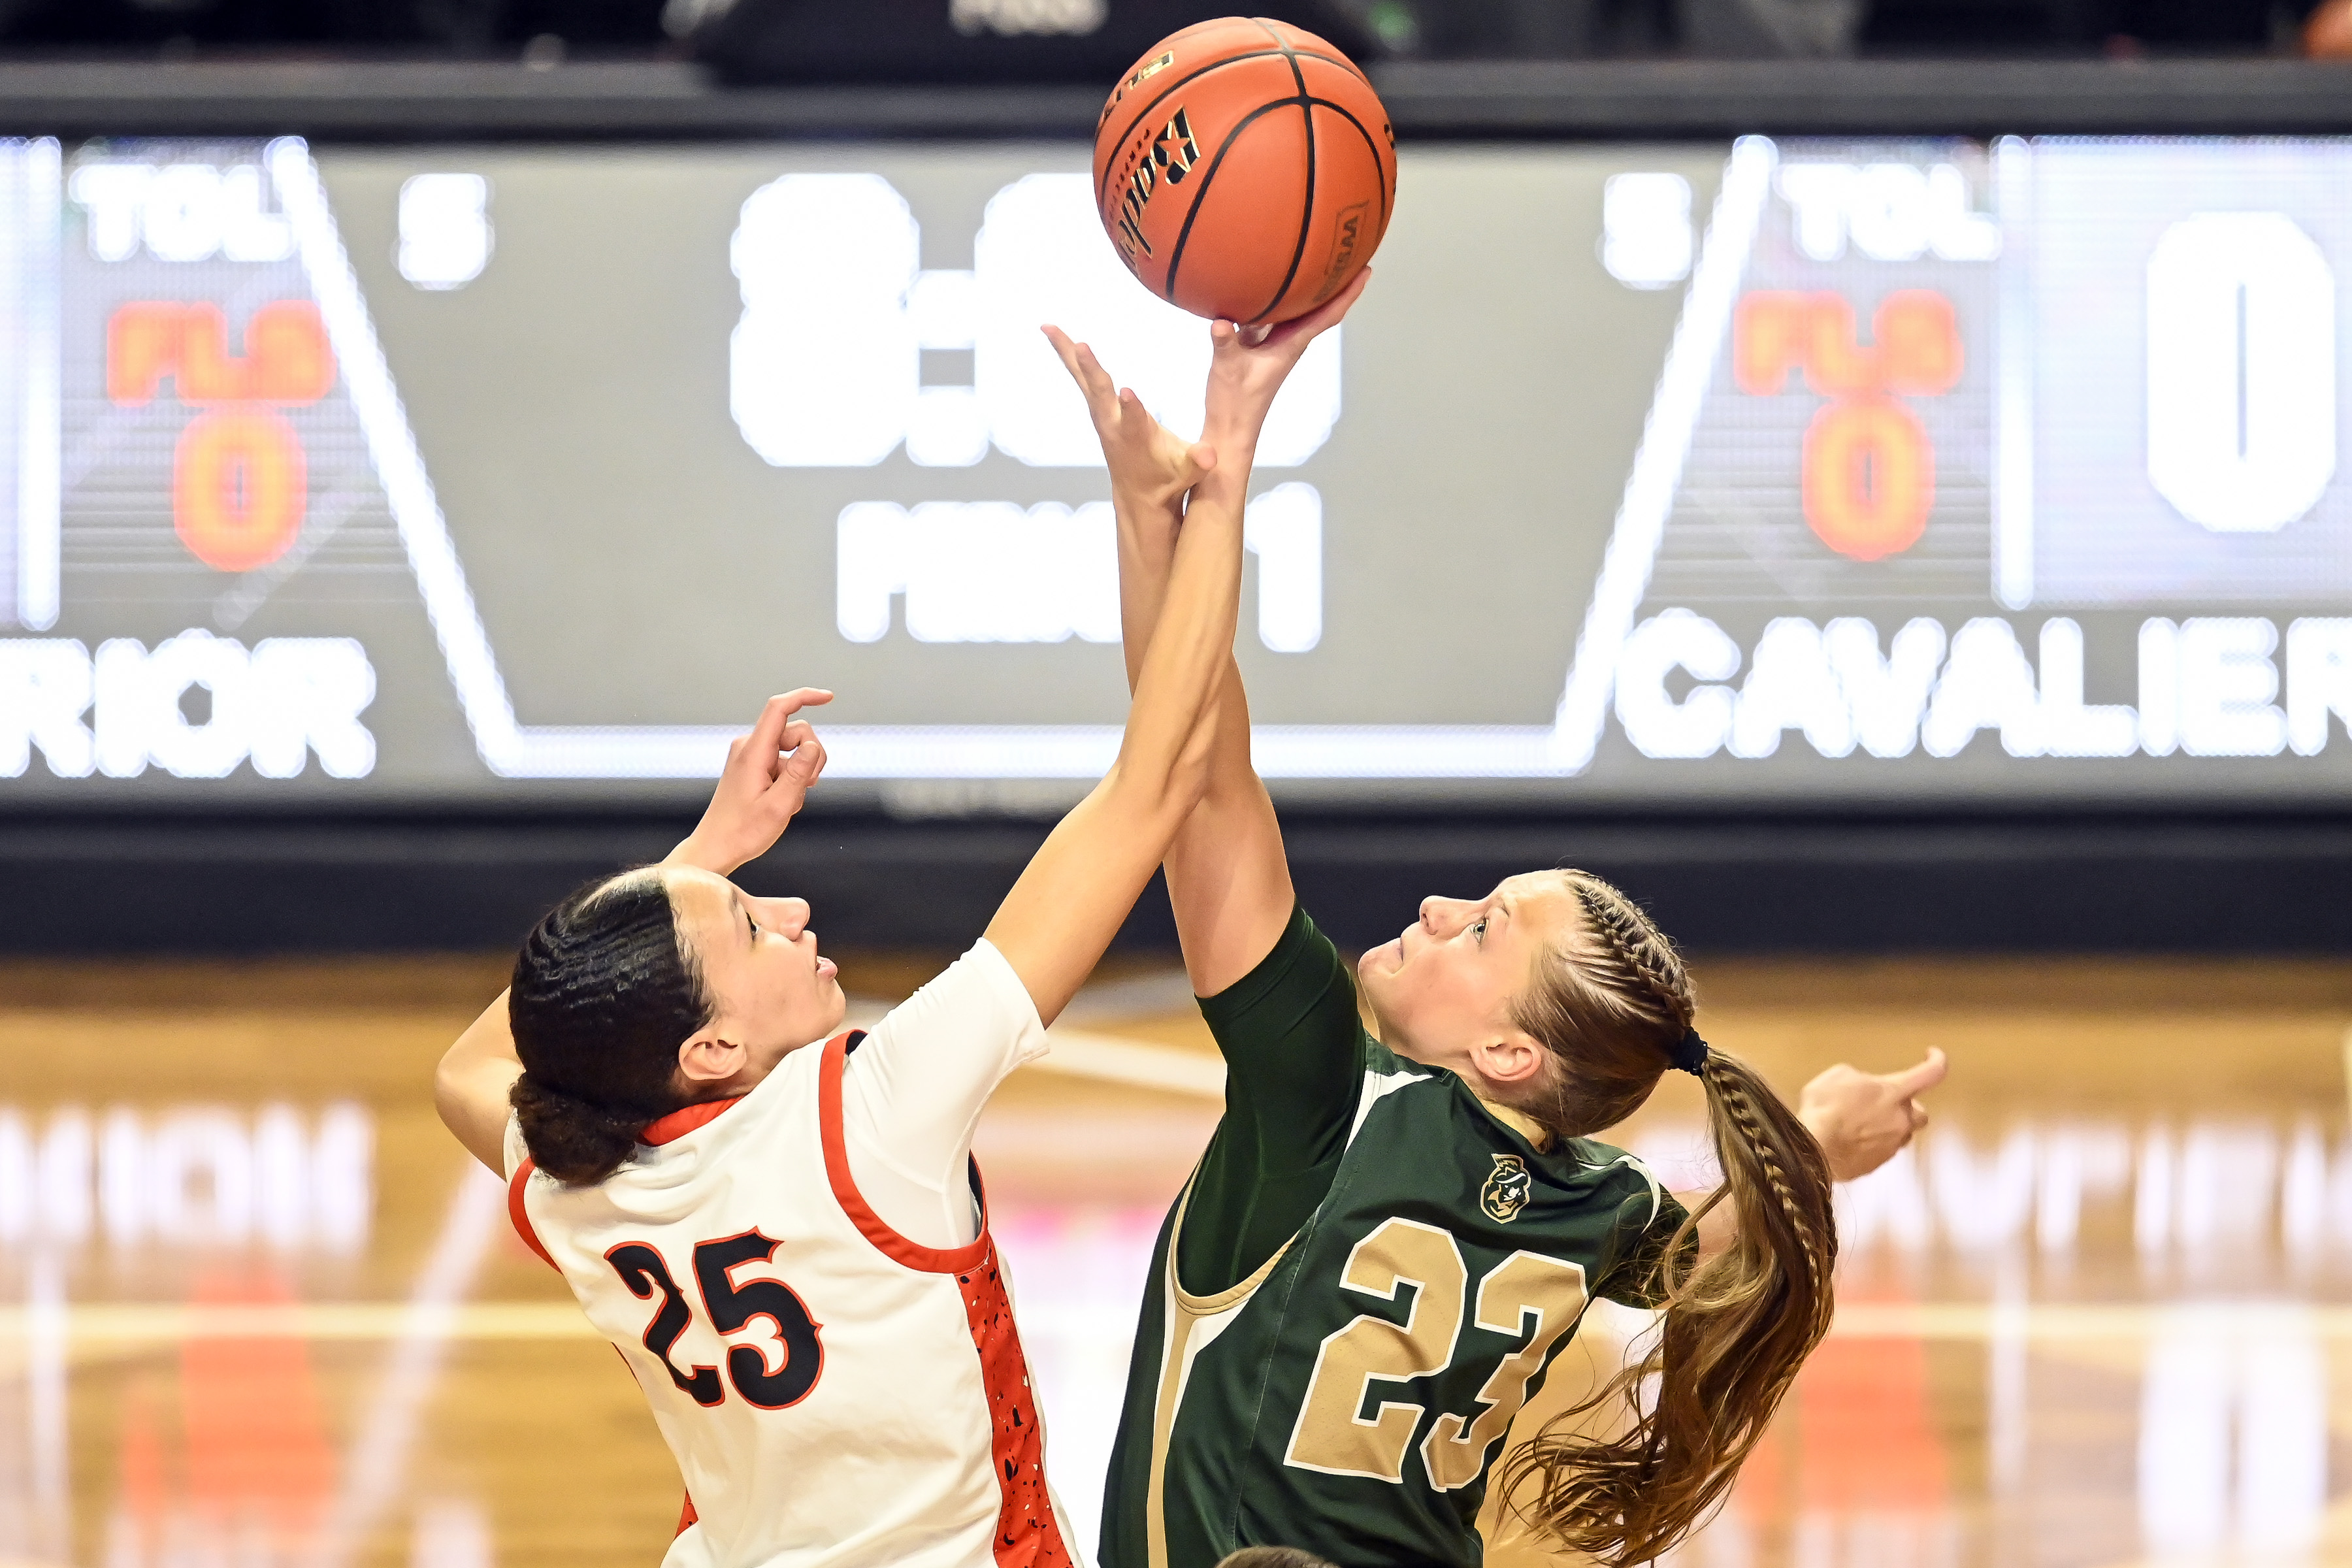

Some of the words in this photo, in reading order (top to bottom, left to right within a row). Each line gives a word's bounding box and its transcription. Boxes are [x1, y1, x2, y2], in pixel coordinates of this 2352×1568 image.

[2146, 211, 2336, 532] 0
[173, 405, 307, 572] 0
[1801, 396, 1935, 562] 0
[603, 1225, 825, 1410] 25
[1282, 1216, 1589, 1493] 23
